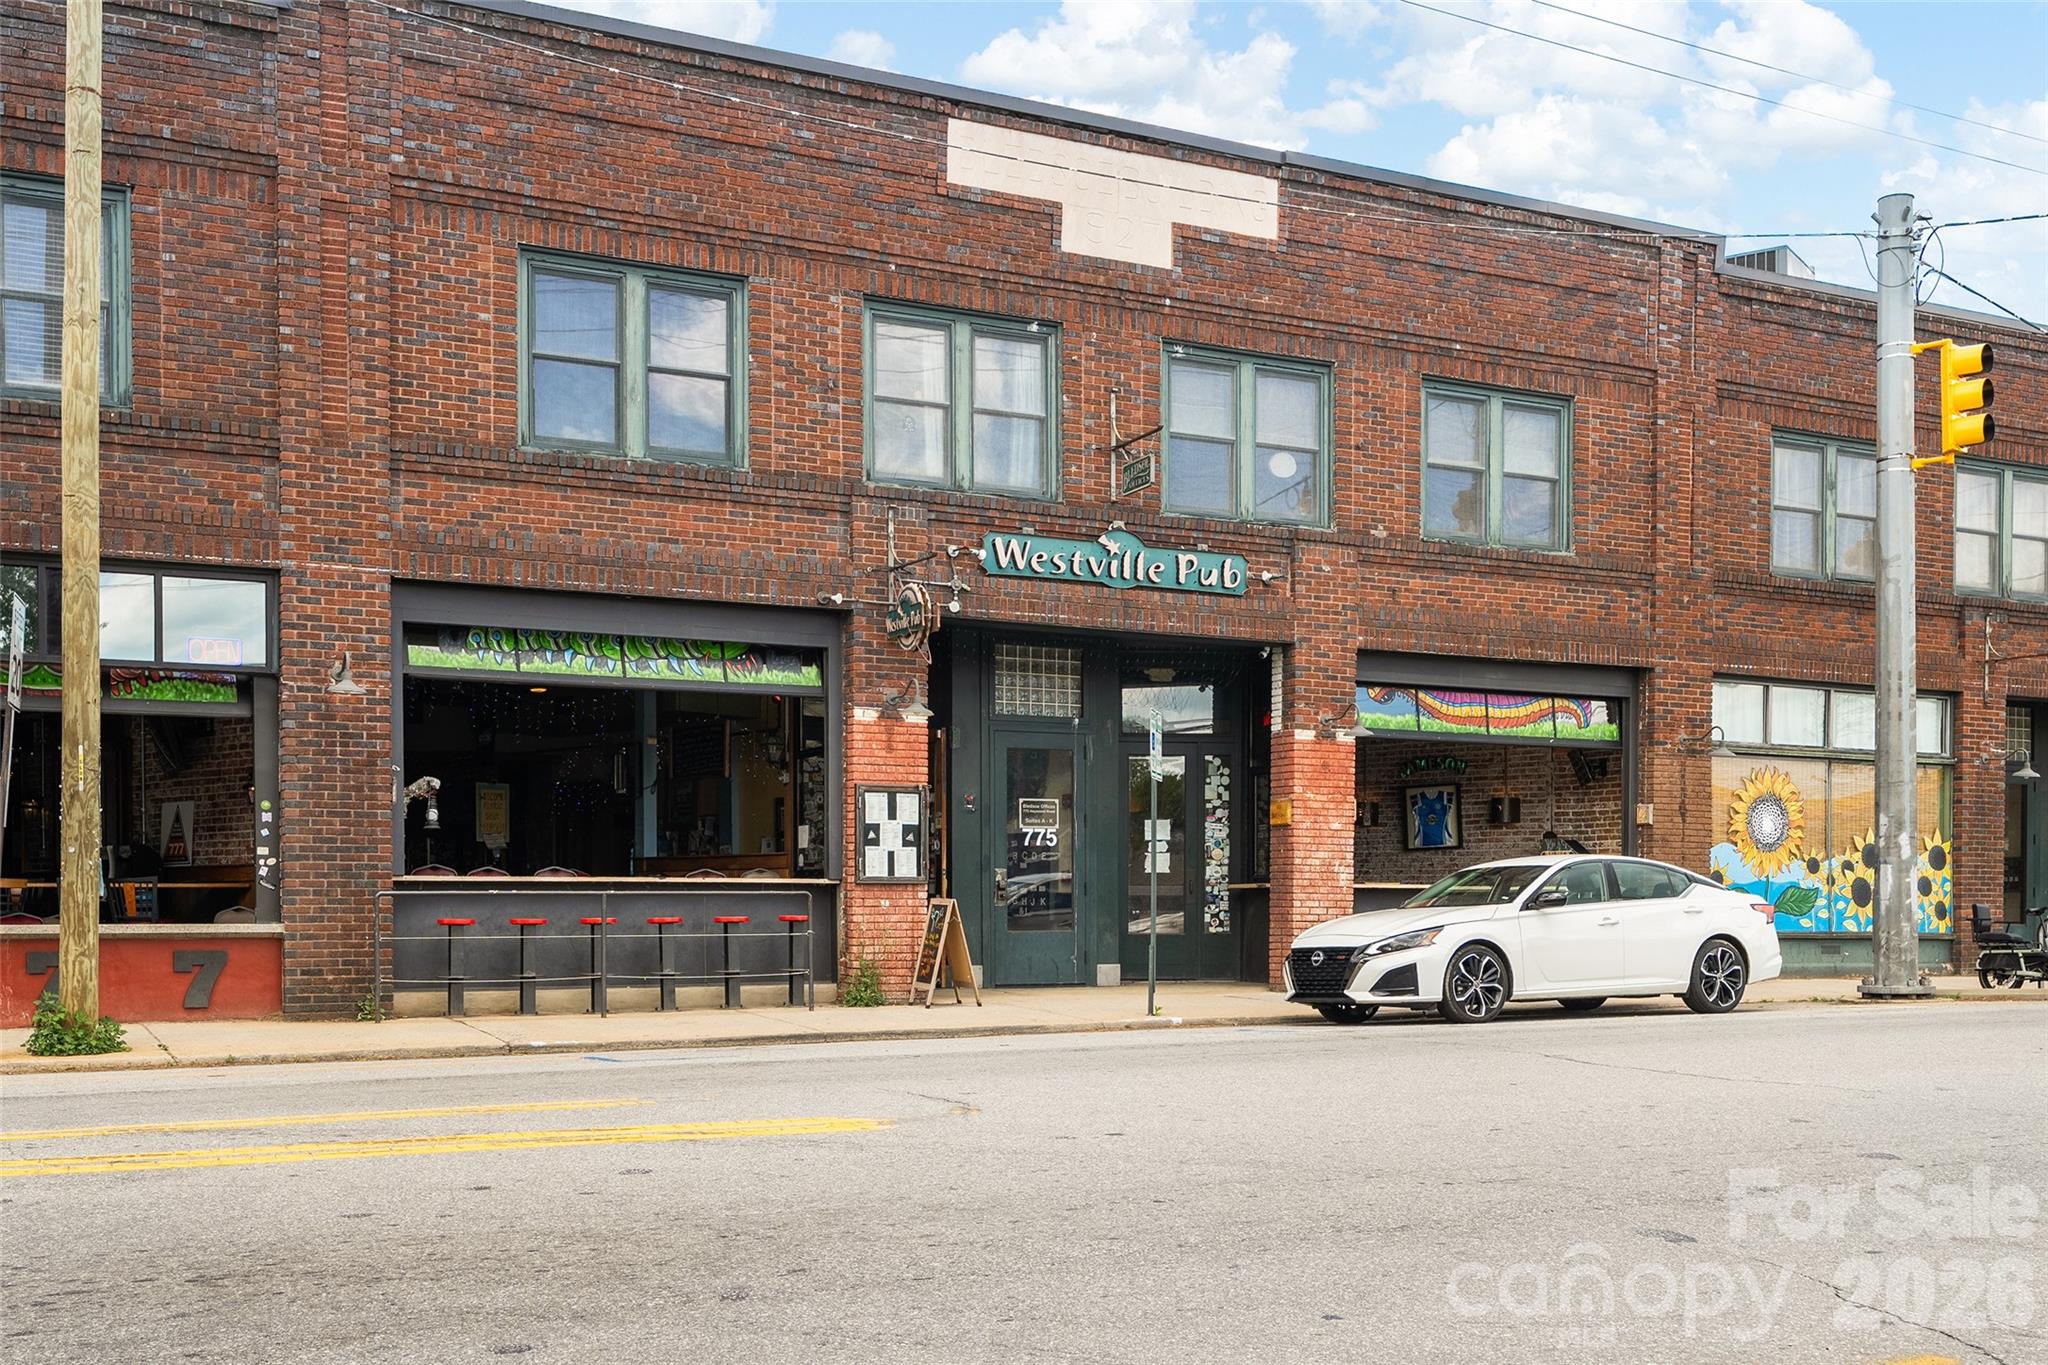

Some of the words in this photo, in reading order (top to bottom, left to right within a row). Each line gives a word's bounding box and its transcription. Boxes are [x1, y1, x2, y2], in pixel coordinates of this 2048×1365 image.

[993, 536, 1166, 583] Westville
[1175, 552, 1242, 589] Pub
[910, 609, 921, 626] Pub
[189, 639, 241, 662] OPEN
[11, 654, 22, 697] 20
[1022, 828, 1057, 847] 775
[172, 950, 229, 1010] 7
